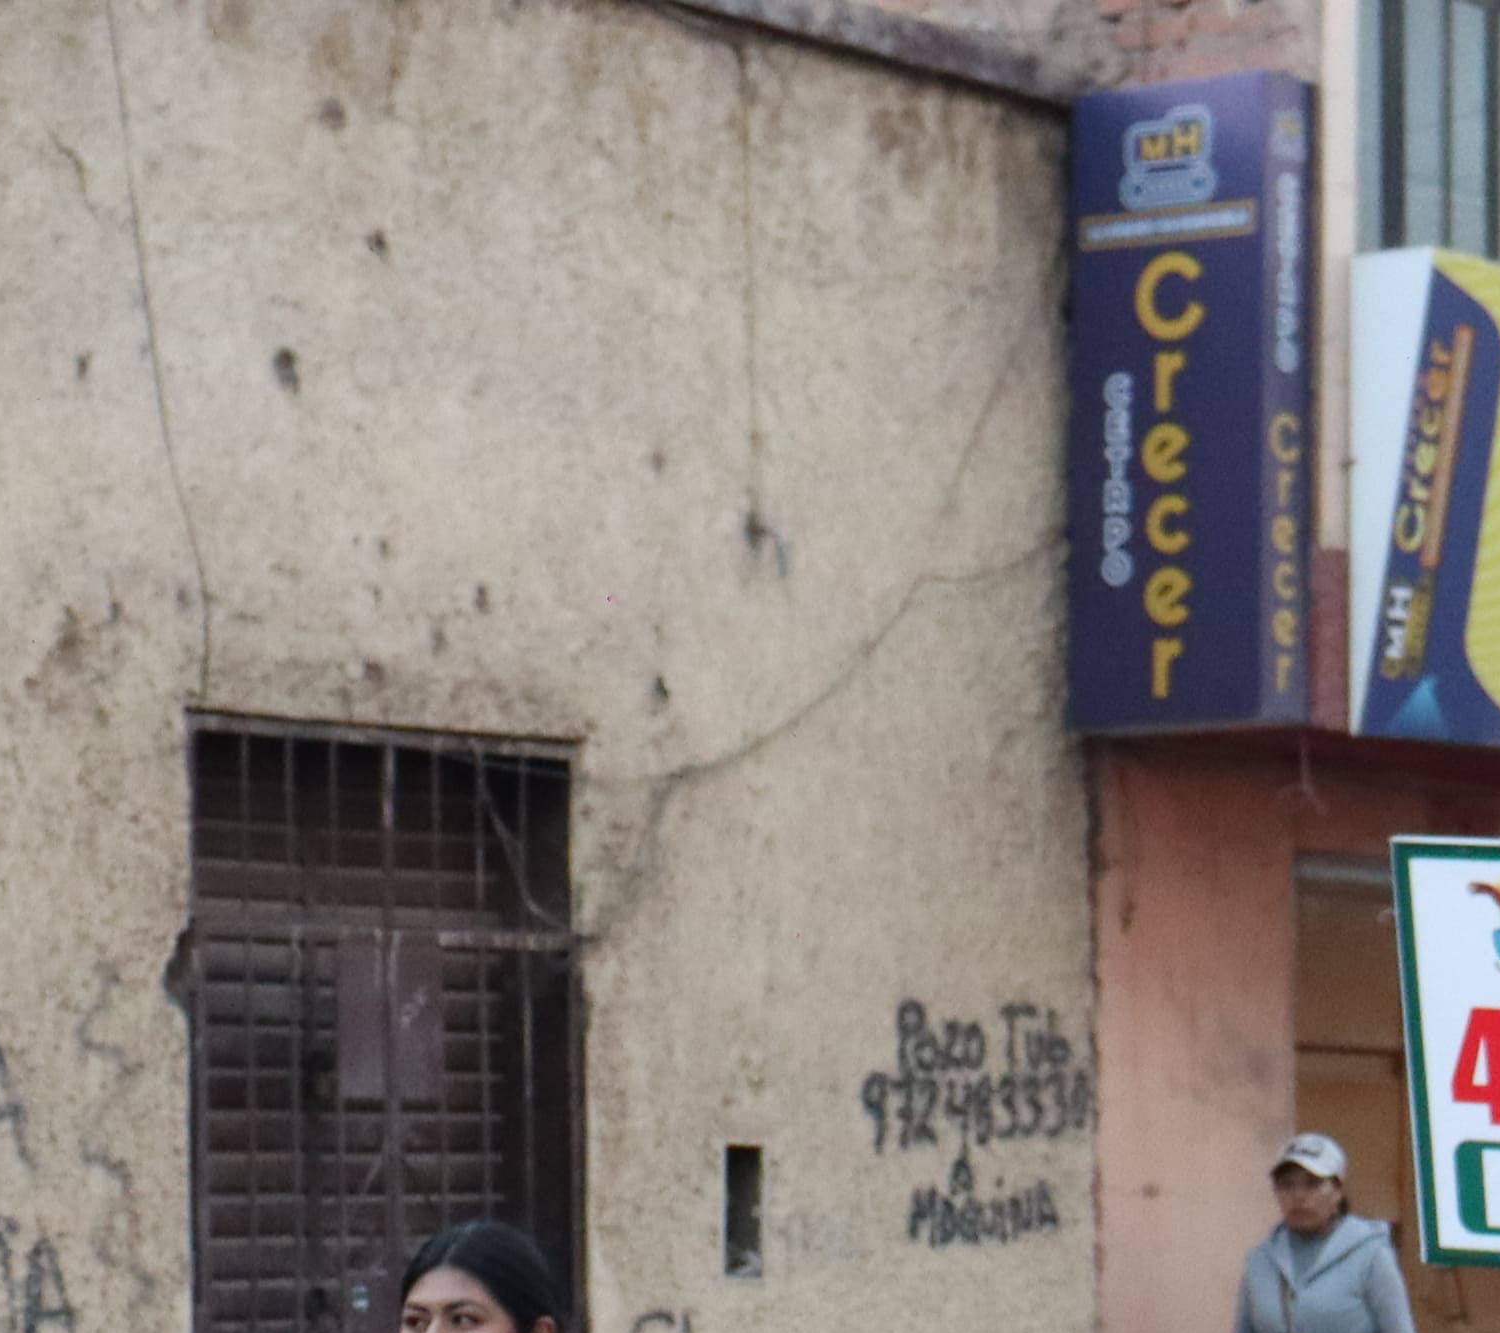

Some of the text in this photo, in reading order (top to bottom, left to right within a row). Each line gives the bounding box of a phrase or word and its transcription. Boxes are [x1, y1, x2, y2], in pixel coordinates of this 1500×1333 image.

[1138, 120, 1202, 162] MH
[1134, 251, 1206, 698] Crecer
[1393, 341, 1456, 554] Crecer
